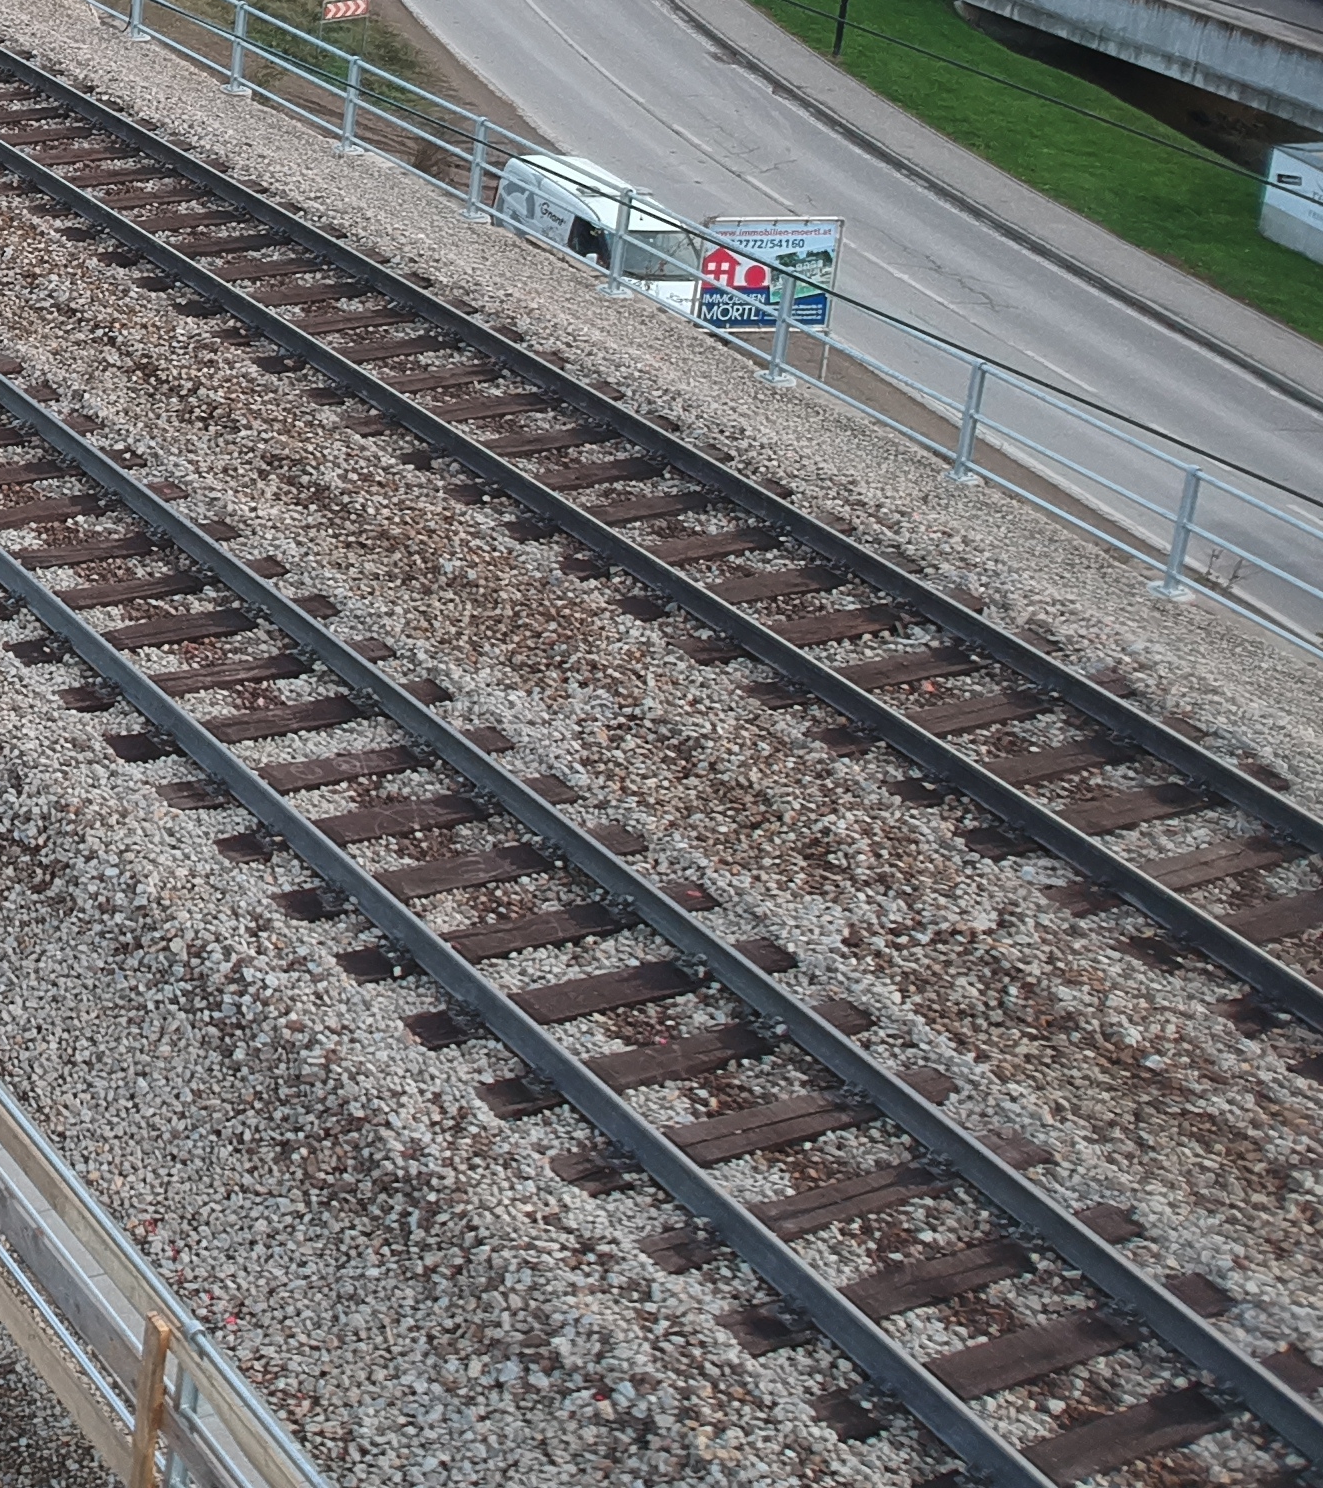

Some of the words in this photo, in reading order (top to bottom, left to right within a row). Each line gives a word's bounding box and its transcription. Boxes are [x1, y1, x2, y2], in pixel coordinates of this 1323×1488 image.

[731, 238, 805, 249] 2772/54160
[702, 293, 766, 304] IMMOIEN
[700, 303, 759, 321] MÖRTL
